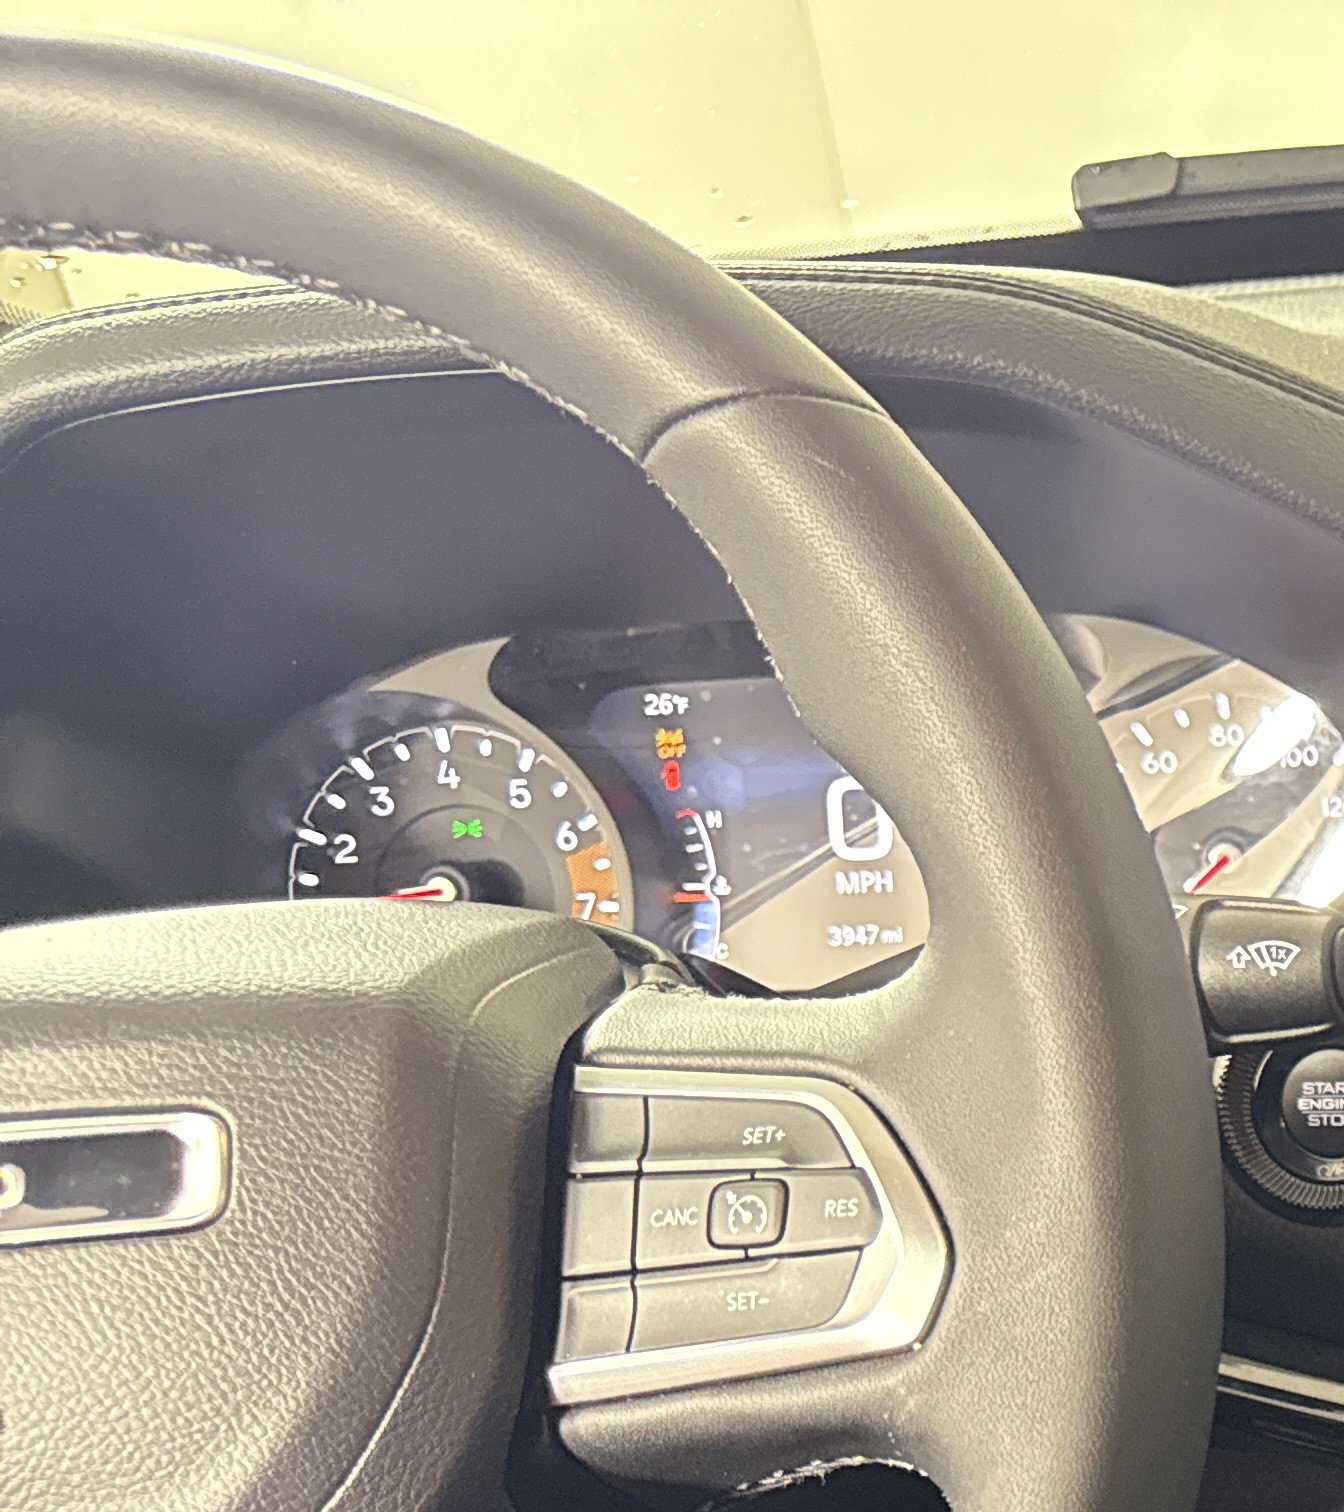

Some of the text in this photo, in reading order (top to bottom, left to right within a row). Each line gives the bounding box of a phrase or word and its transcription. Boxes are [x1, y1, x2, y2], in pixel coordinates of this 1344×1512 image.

[1207, 723, 1244, 748] 80
[437, 759, 461, 790] 4
[1140, 750, 1178, 775] 60
[369, 785, 395, 817] 3
[508, 778, 532, 809] 5
[705, 810, 723, 829] H
[826, 774, 894, 862] 0
[332, 833, 359, 865] 2
[555, 821, 578, 852] 6
[834, 870, 894, 895] MPH
[575, 892, 597, 921] 7
[826, 922, 904, 947] 3947 mi
[742, 1125, 787, 1146] SET+
[650, 1206, 699, 1228] CANC
[824, 1198, 860, 1218] RES
